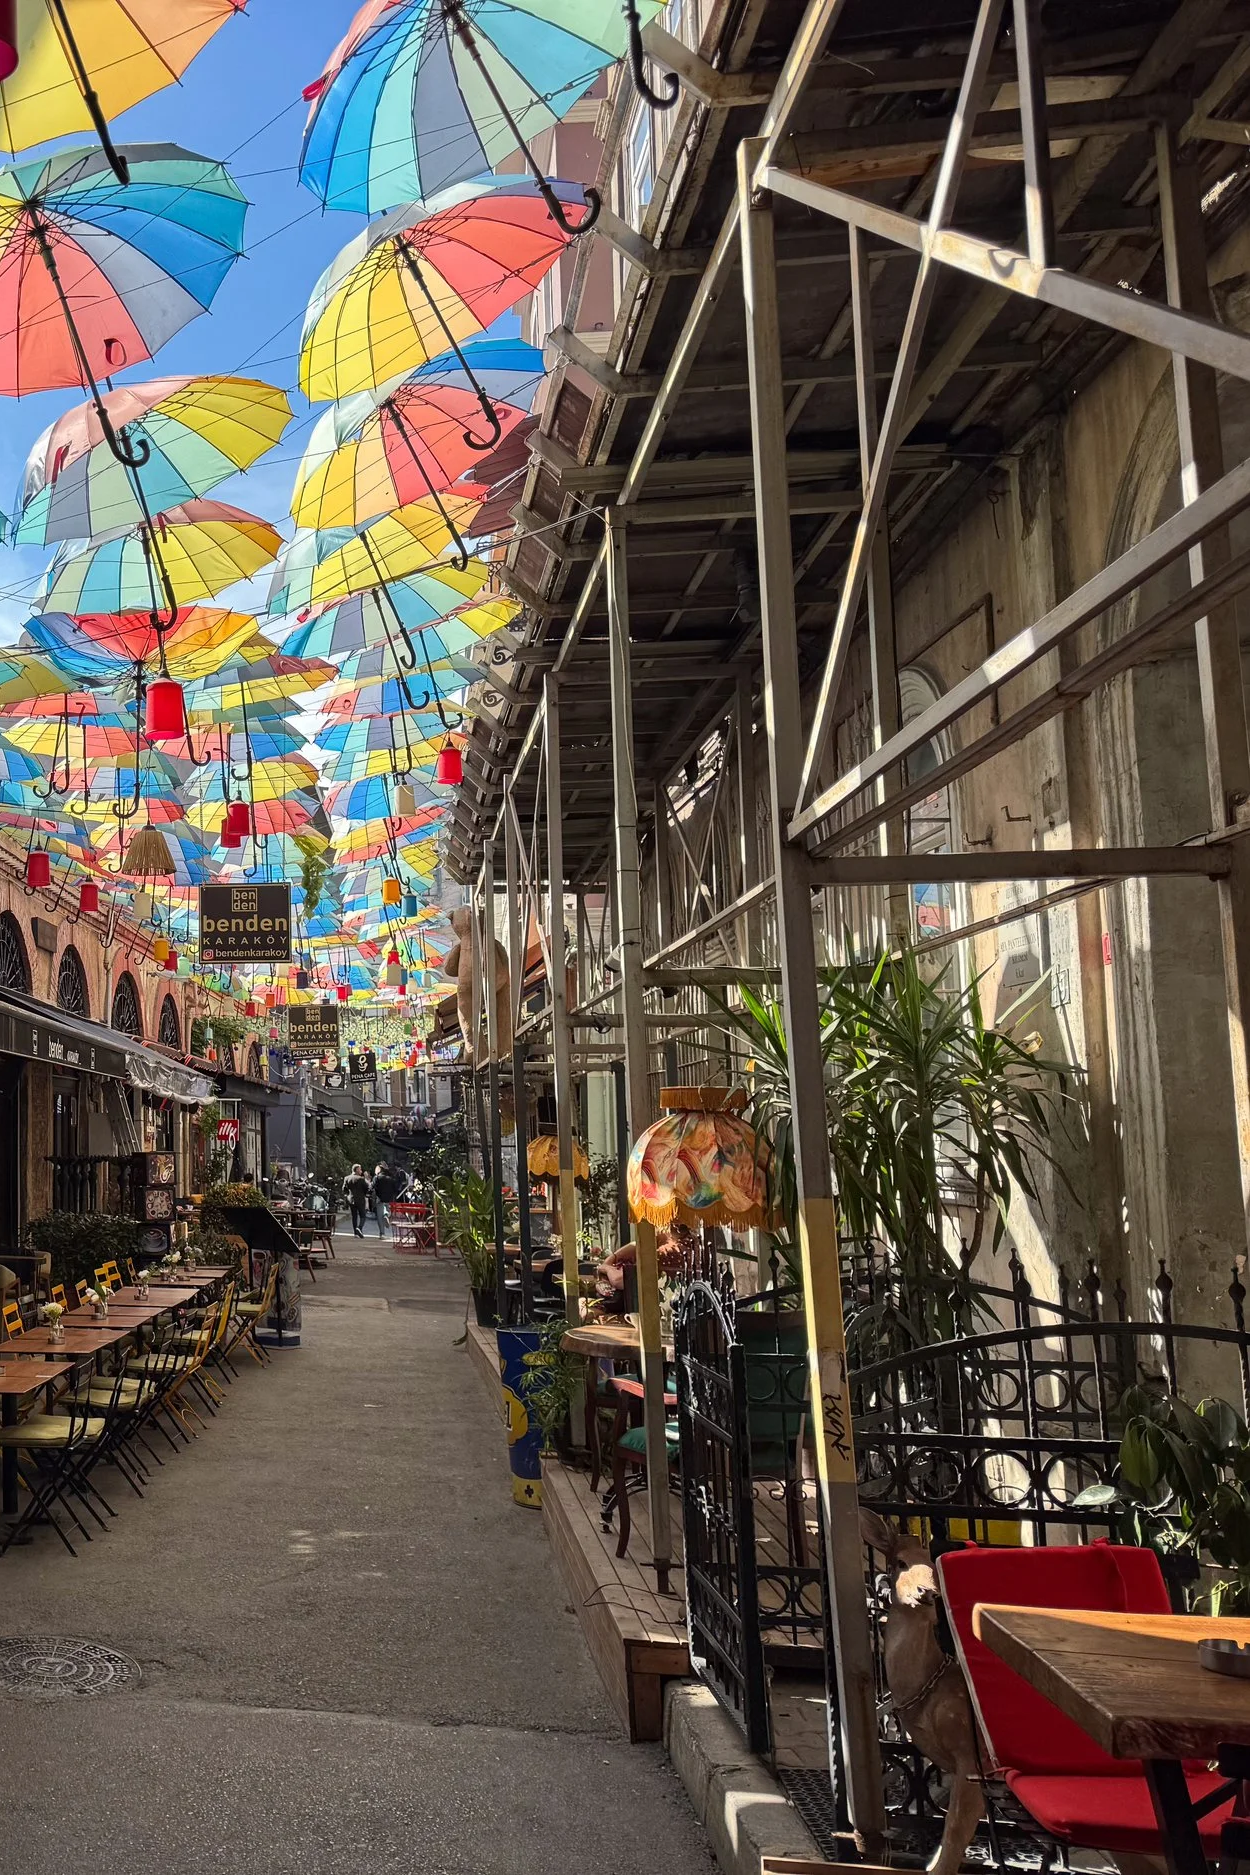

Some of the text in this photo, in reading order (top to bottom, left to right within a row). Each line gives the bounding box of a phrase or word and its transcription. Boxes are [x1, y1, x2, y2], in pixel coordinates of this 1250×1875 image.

[233, 890, 256, 900] ben
[233, 900, 256, 910] den
[202, 914, 287, 932] benden
[203, 935, 287, 945] KARAKÖY
[215, 948, 288, 958] bendenkarakoy
[290, 1022, 337, 1032] benden
[218, 1122, 238, 1150] illy
